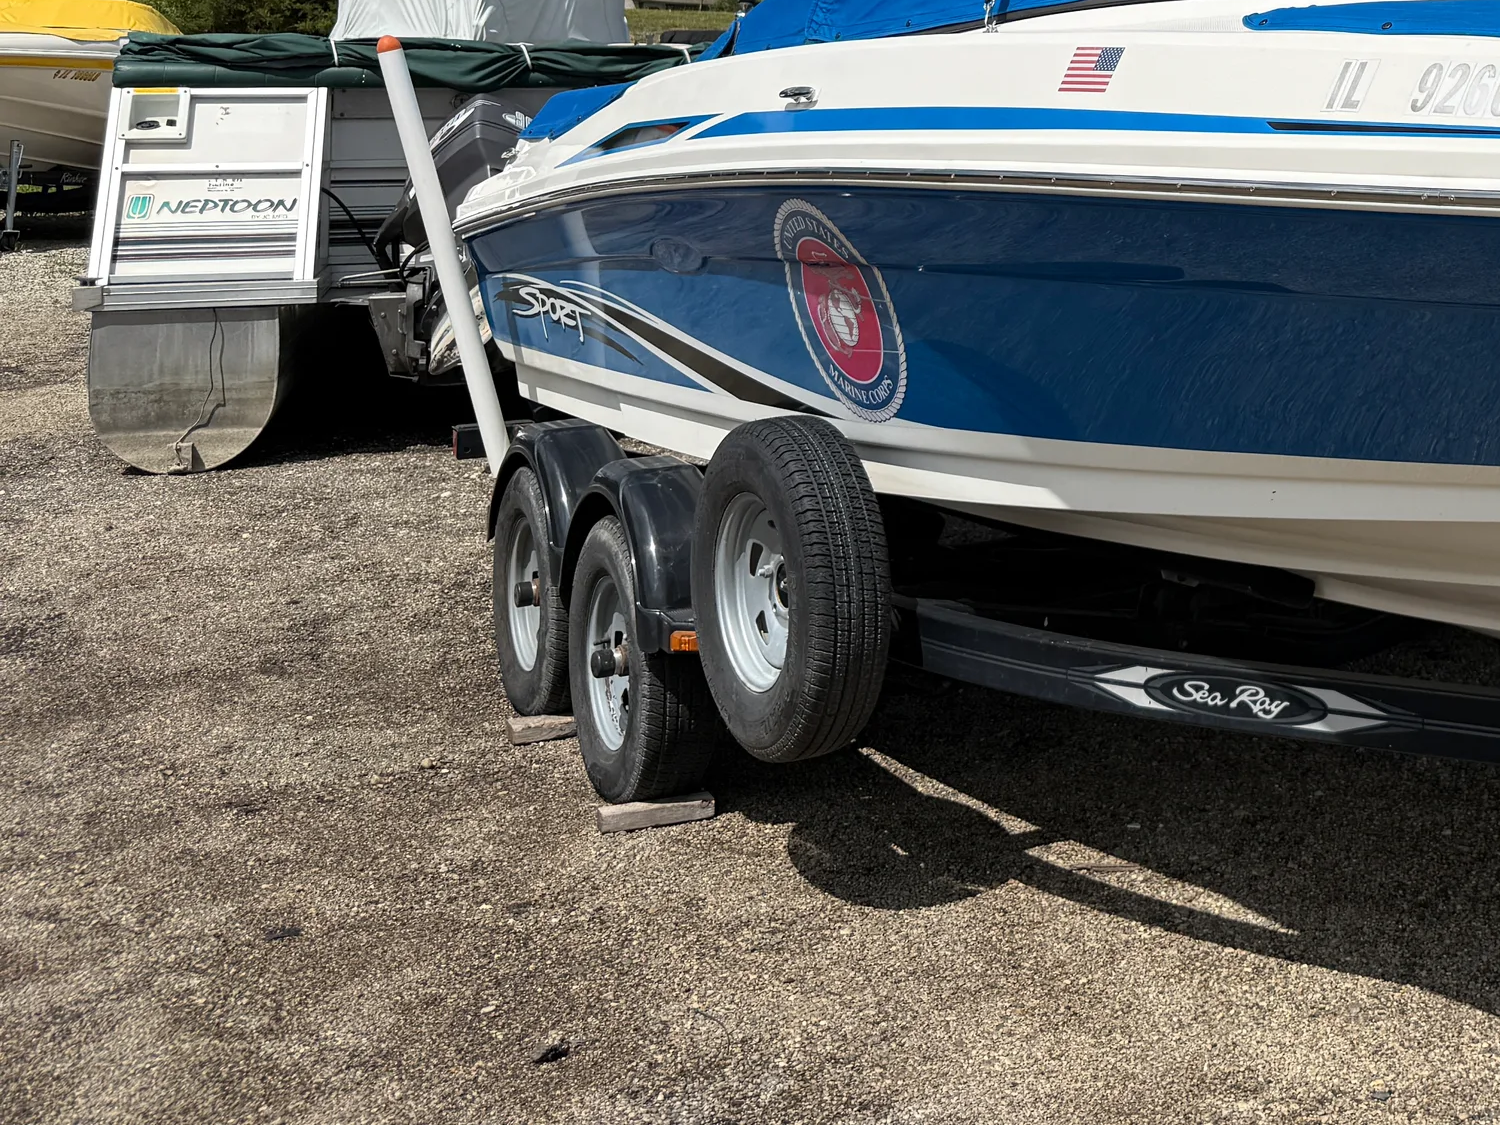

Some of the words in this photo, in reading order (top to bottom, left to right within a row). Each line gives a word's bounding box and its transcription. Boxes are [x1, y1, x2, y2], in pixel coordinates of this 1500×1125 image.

[1326, 61, 1369, 110] IL
[156, 197, 298, 215] NEPTOON
[783, 215, 806, 250] UNITED
[806, 216, 850, 260] STATES
[512, 286, 592, 343] SPORT
[829, 363, 869, 405] MARINE
[869, 374, 894, 404] CORPS
[1172, 680, 1229, 707] Sea
[1229, 685, 1290, 719] Ray
